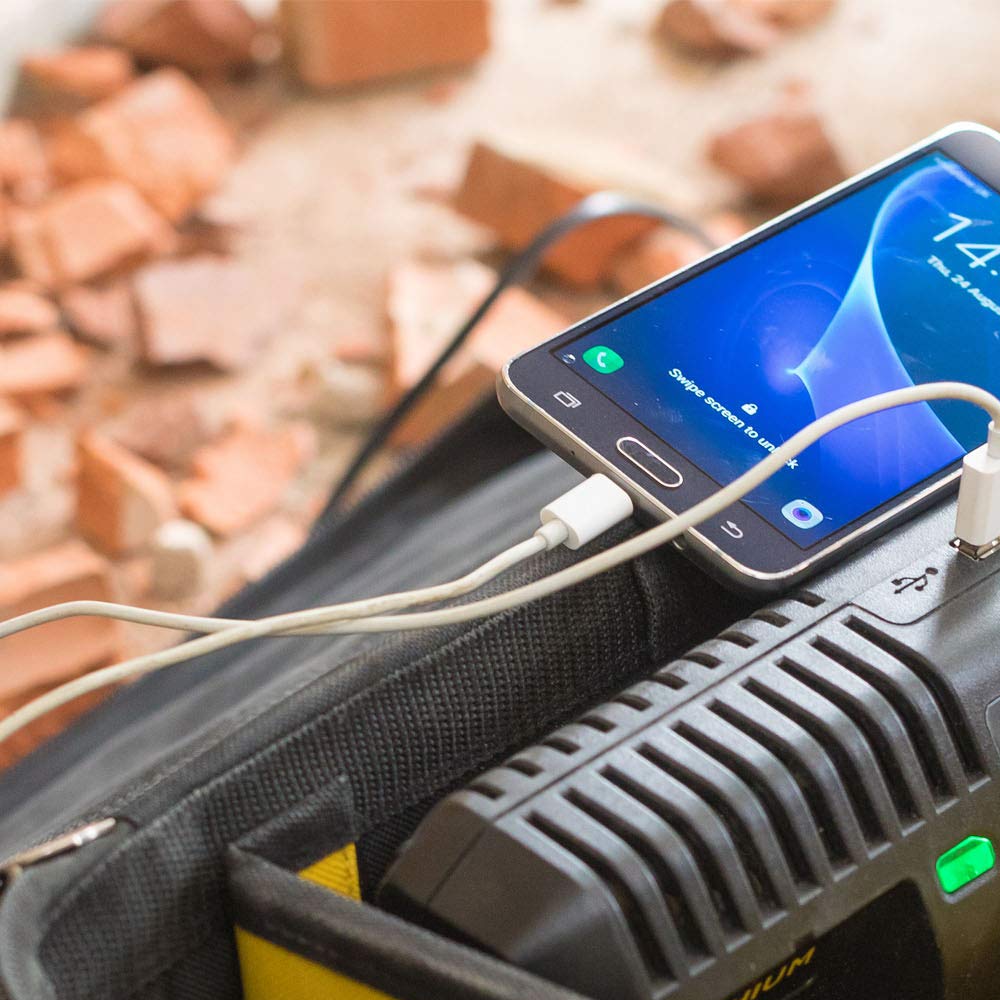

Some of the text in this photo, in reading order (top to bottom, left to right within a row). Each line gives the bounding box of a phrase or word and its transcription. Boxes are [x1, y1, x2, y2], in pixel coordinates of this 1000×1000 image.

[950, 273, 971, 289] 24
[668, 367, 706, 398] Swipe
[704, 397, 745, 429] screen
[744, 426, 759, 438] to
